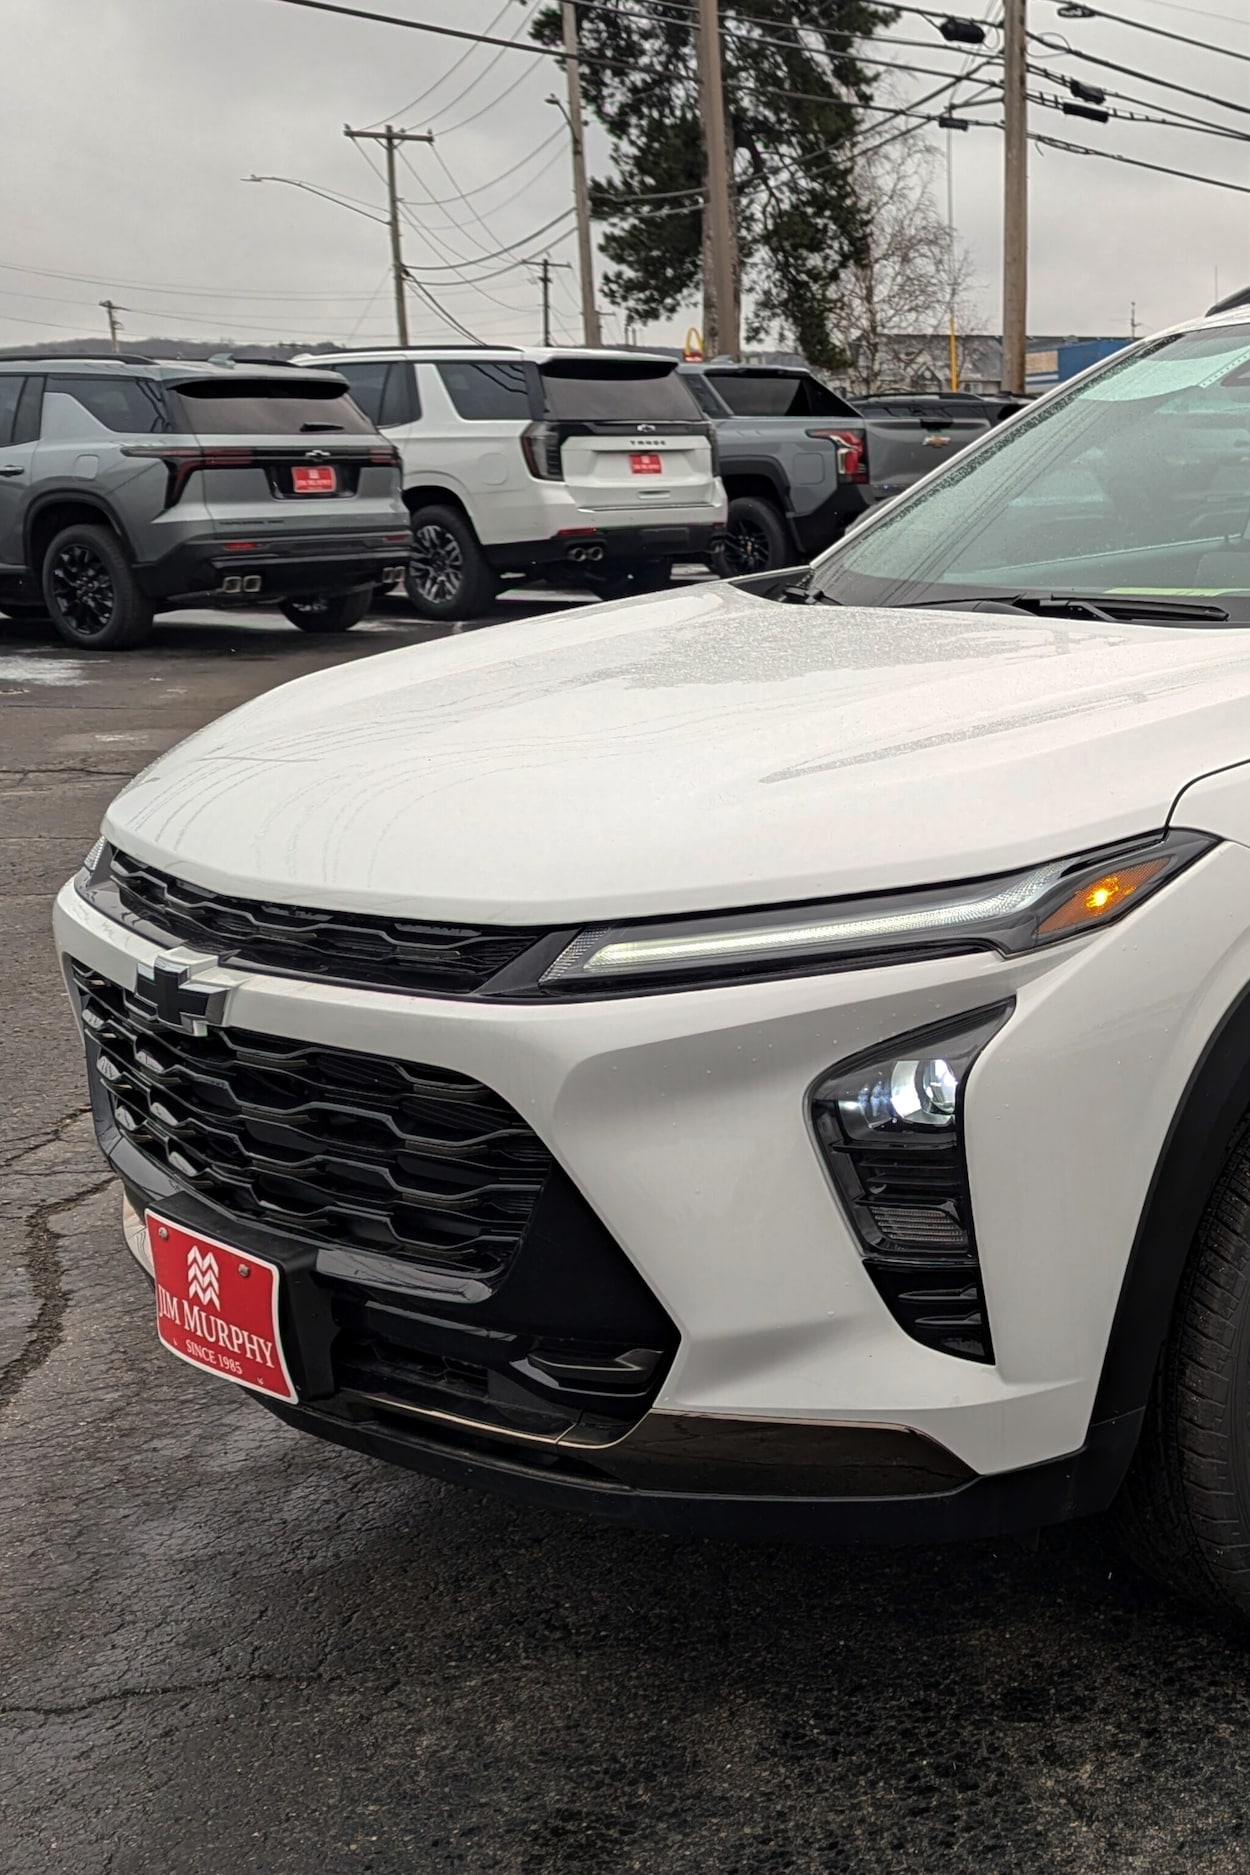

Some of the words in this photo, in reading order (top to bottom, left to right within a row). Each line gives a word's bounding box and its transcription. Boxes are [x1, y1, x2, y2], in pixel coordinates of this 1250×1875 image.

[158, 1284, 181, 1326] JIM
[183, 1299, 275, 1369] MURPHY
[186, 1339, 217, 1364] SINCE
[218, 1353, 243, 1375] 1985
